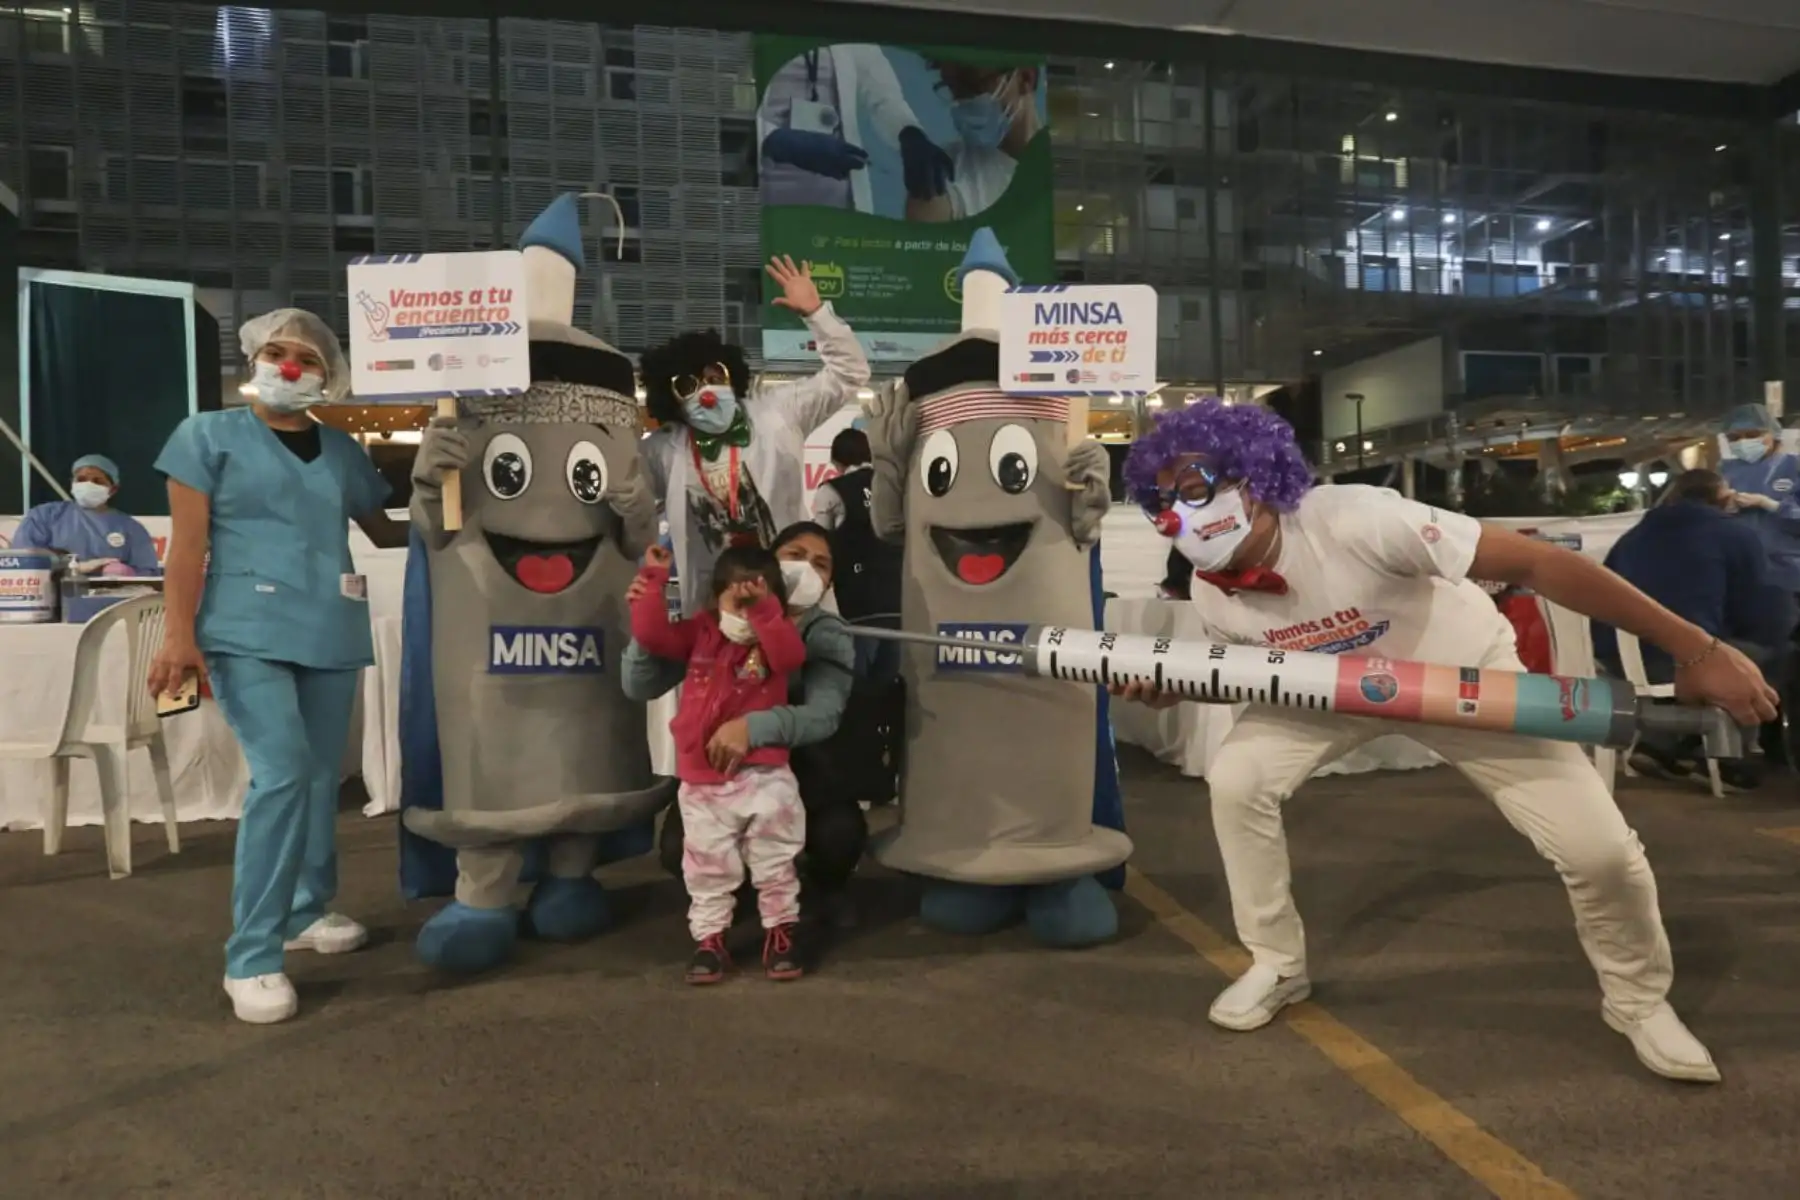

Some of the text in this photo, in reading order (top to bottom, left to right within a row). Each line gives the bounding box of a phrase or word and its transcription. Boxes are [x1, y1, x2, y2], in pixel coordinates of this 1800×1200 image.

[389, 287, 513, 308] Vamos a tu
[395, 305, 510, 326] encuentro
[1035, 302, 1123, 325] MINSA
[1028, 327, 1128, 345] más cerca
[1081, 346, 1127, 363] de ti
[1262, 620, 1321, 643] Vamos
[1321, 616, 1335, 629] a
[1335, 606, 1361, 624] tu
[493, 632, 602, 667] MINSA
[938, 629, 1023, 665] MINS
[1267, 650, 1286, 664] 50
